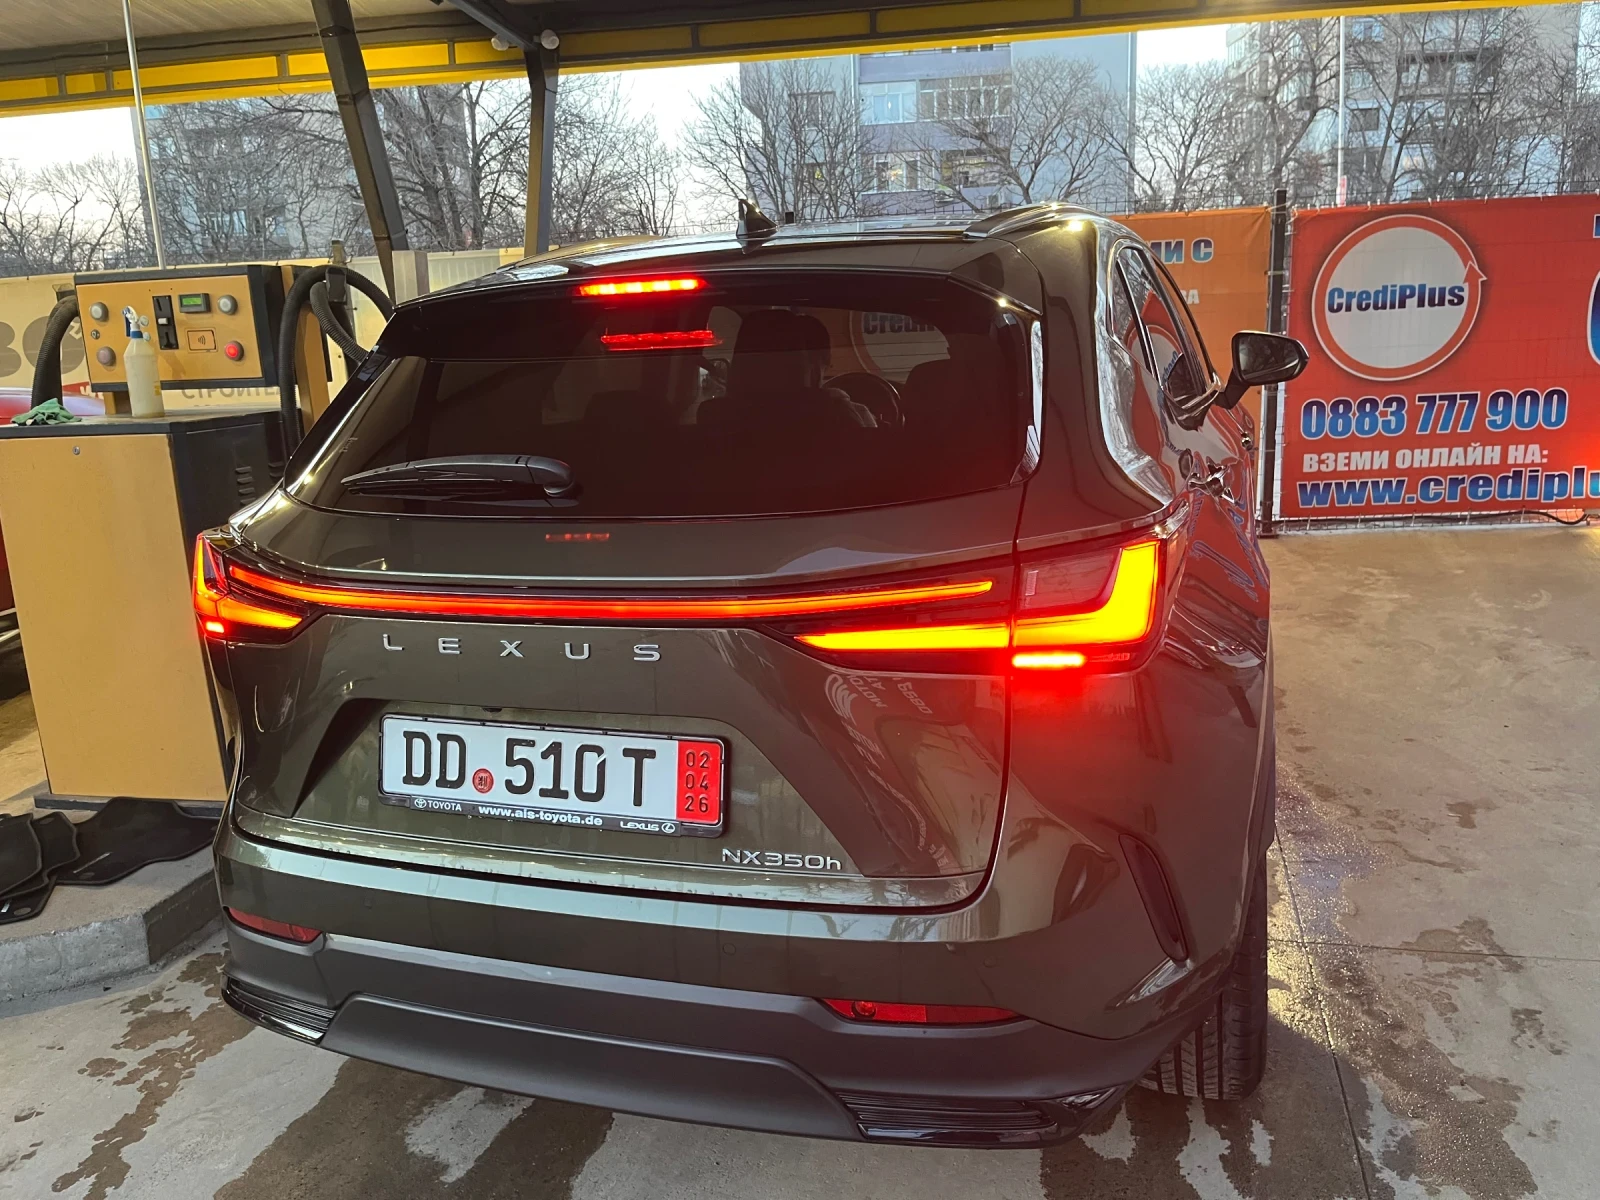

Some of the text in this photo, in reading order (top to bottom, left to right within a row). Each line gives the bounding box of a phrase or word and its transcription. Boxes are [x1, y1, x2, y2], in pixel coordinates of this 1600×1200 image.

[1327, 283, 1465, 314] CrediPlus
[1301, 387, 1568, 440] 0883 777 900
[1303, 442, 1548, 473] ВЗЕМИ ОНЛАЙН НА:
[382, 633, 661, 662] LEXUS
[402, 730, 467, 789] DD
[504, 738, 607, 802] 510
[622, 747, 657, 807] T
[685, 750, 710, 769] 02
[684, 772, 709, 791] 04
[427, 799, 462, 812] TOYOTA
[619, 820, 660, 832] LEXUS
[684, 794, 709, 813] 26
[722, 848, 842, 870] NX350h
